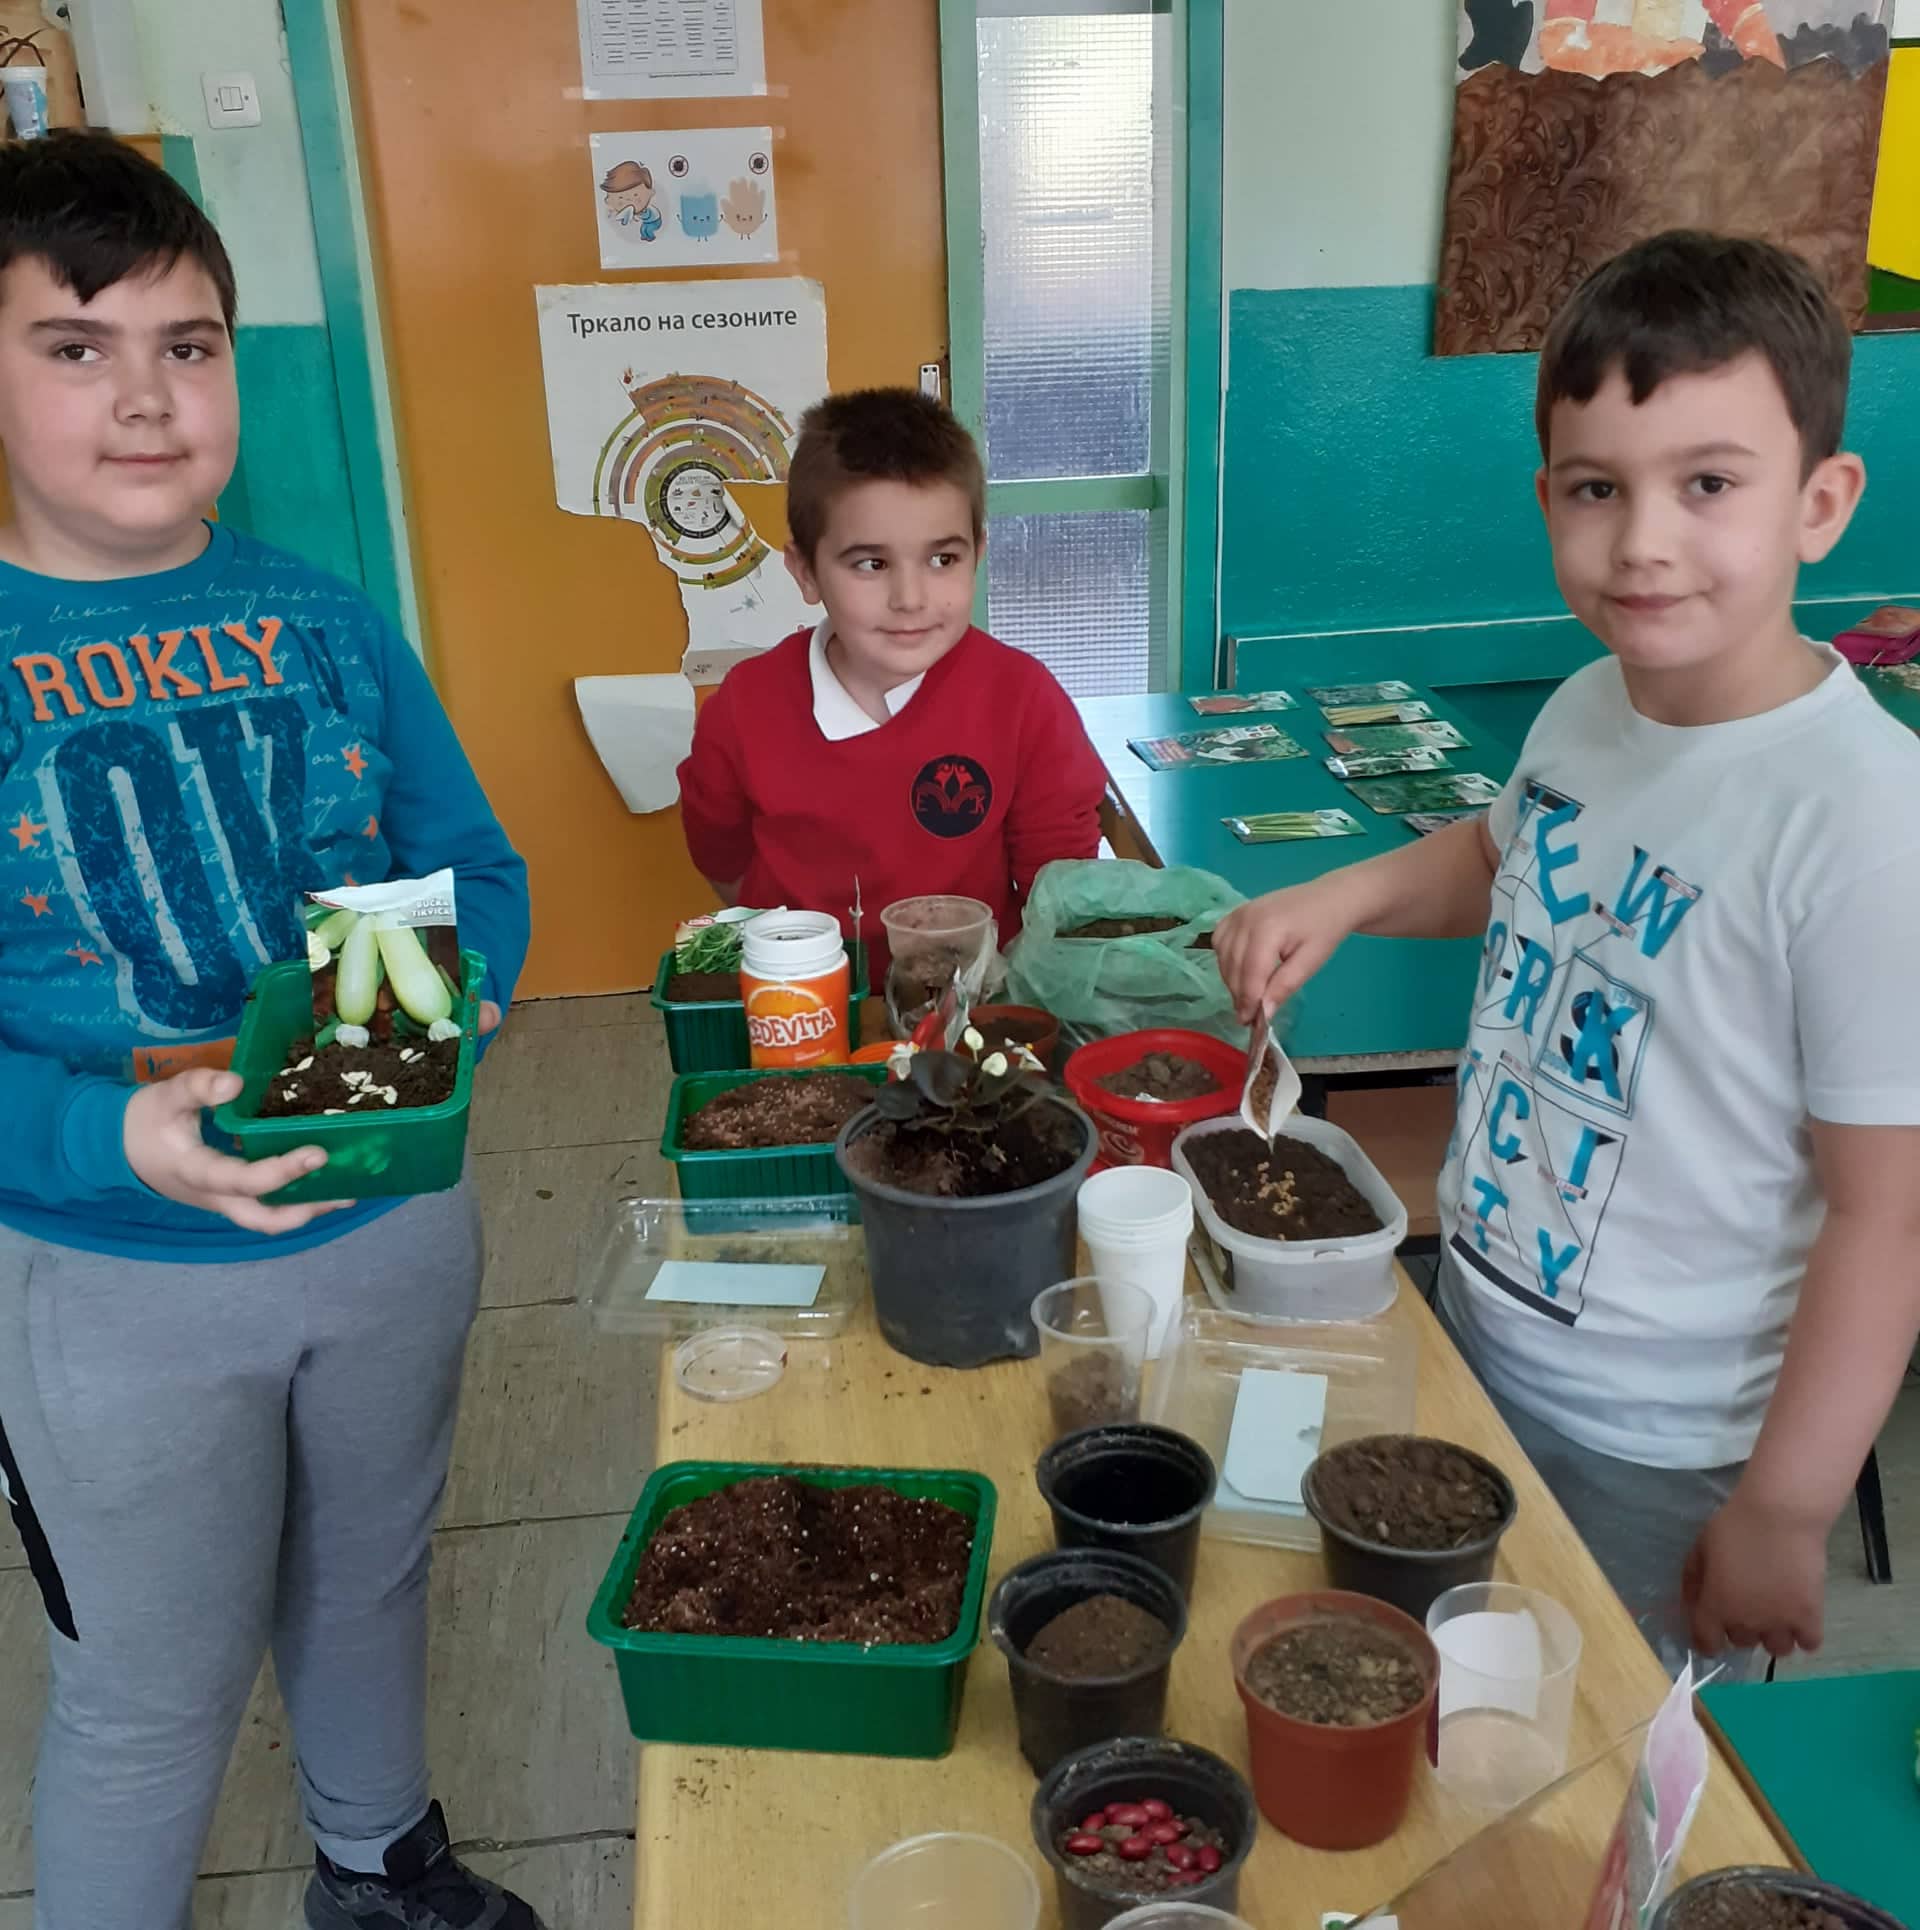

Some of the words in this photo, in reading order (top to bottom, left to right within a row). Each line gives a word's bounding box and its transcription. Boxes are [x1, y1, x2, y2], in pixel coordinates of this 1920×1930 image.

[567, 313, 651, 338] Тркало
[658, 314, 685, 331] на
[692, 310, 797, 329] сезоните
